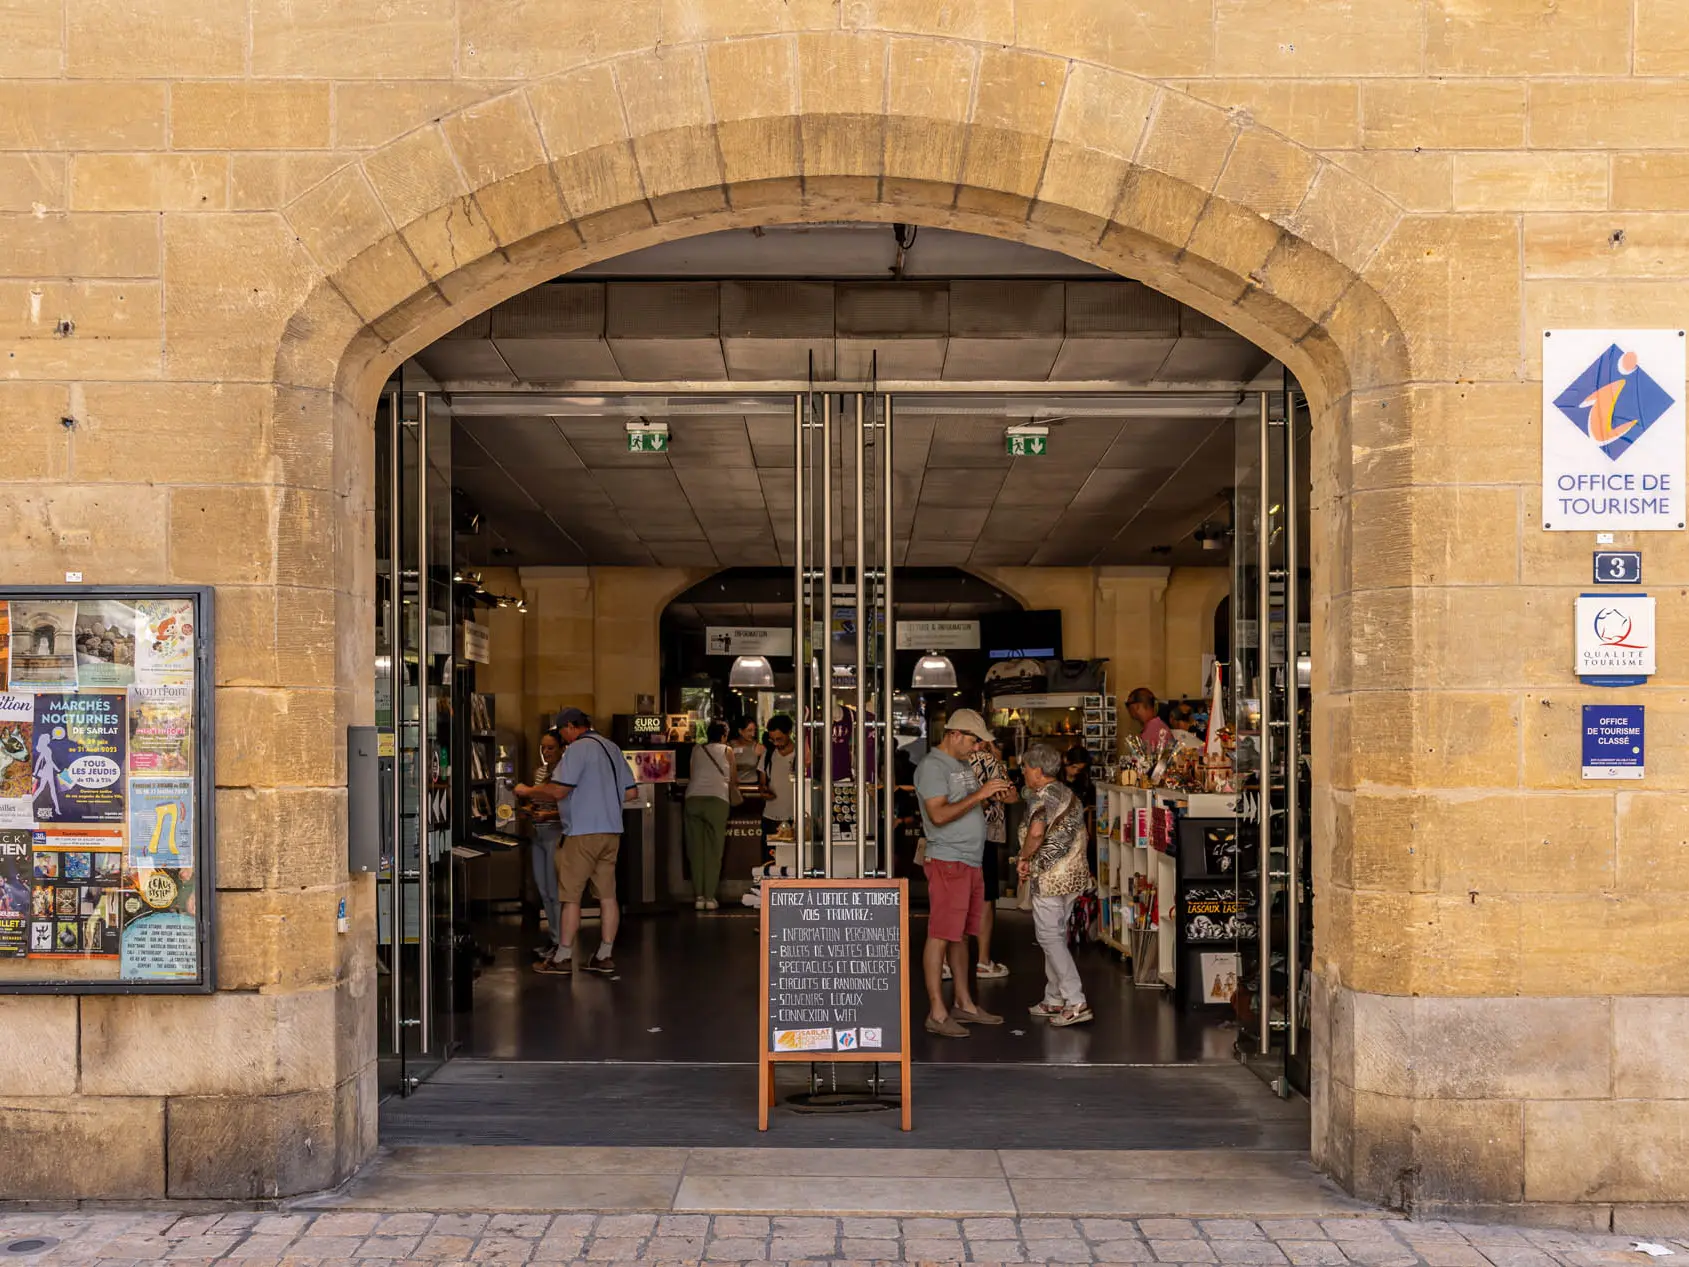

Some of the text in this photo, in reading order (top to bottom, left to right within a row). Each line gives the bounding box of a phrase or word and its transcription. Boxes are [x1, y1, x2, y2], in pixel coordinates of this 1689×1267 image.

[1557, 474, 1671, 491] OFFICE DE
[1559, 498, 1670, 514] TOURISME
[1609, 557, 1626, 578] 3
[1583, 650, 1643, 659] QUALITÉ
[50, 698, 111, 711] MARCHÉS
[41, 713, 119, 724] NOCTURNES
[1599, 717, 1628, 726] OFFICE
[1587, 727, 1641, 735] DE TOURISME
[1598, 736, 1630, 745] CLASSÉ
[83, 760, 106, 768] TOUS
[726, 828, 763, 837] WELCO
[771, 890, 900, 906] ENTREZ À L'OFFICE DE TOURISME
[800, 908, 820, 920] VOUS
[1187, 904, 1220, 914] LASCAUX
[782, 928, 840, 942] INFORMATION
[780, 943, 900, 959] BILLETS DE VISITES GUIDÉES
[779, 960, 896, 974] SPECTACLES ET CONCERTS
[779, 976, 889, 990] CIRCUITS DE RANDONNÉES
[779, 992, 864, 1006] SOUVENIRS LOCAUX
[779, 1008, 857, 1022] CONNEXION WIFI
